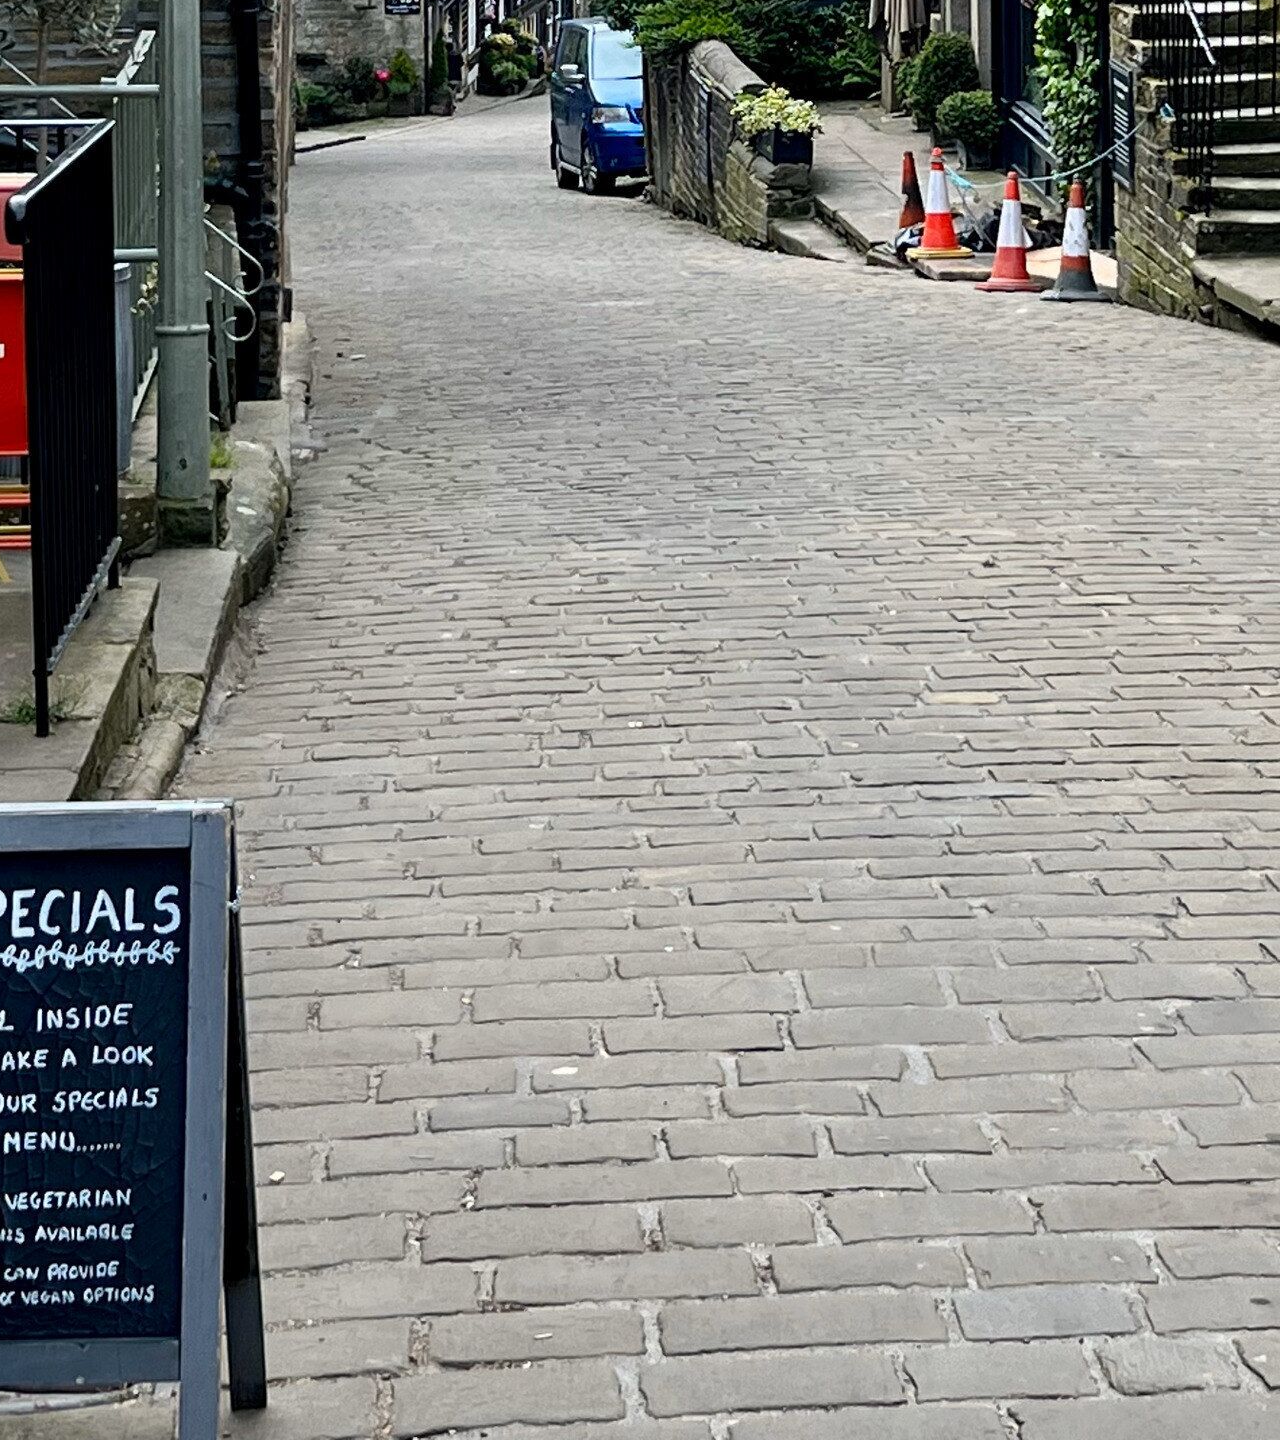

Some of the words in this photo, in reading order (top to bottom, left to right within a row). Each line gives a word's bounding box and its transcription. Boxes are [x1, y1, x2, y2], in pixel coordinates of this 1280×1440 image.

[36, 1003, 133, 1032] INSIDE
[61, 1047, 77, 1068] A
[92, 1045, 154, 1067] LOOK
[51, 1086, 160, 1113] SPECIALS
[4, 1188, 132, 1211] VEGETARIAN
[34, 1222, 135, 1243] AVAILABLE
[3, 1266, 40, 1282] CAN
[46, 1260, 120, 1282] PROVIDE
[20, 1289, 76, 1306] VEGAN
[83, 1284, 155, 1305] OPTIONS
